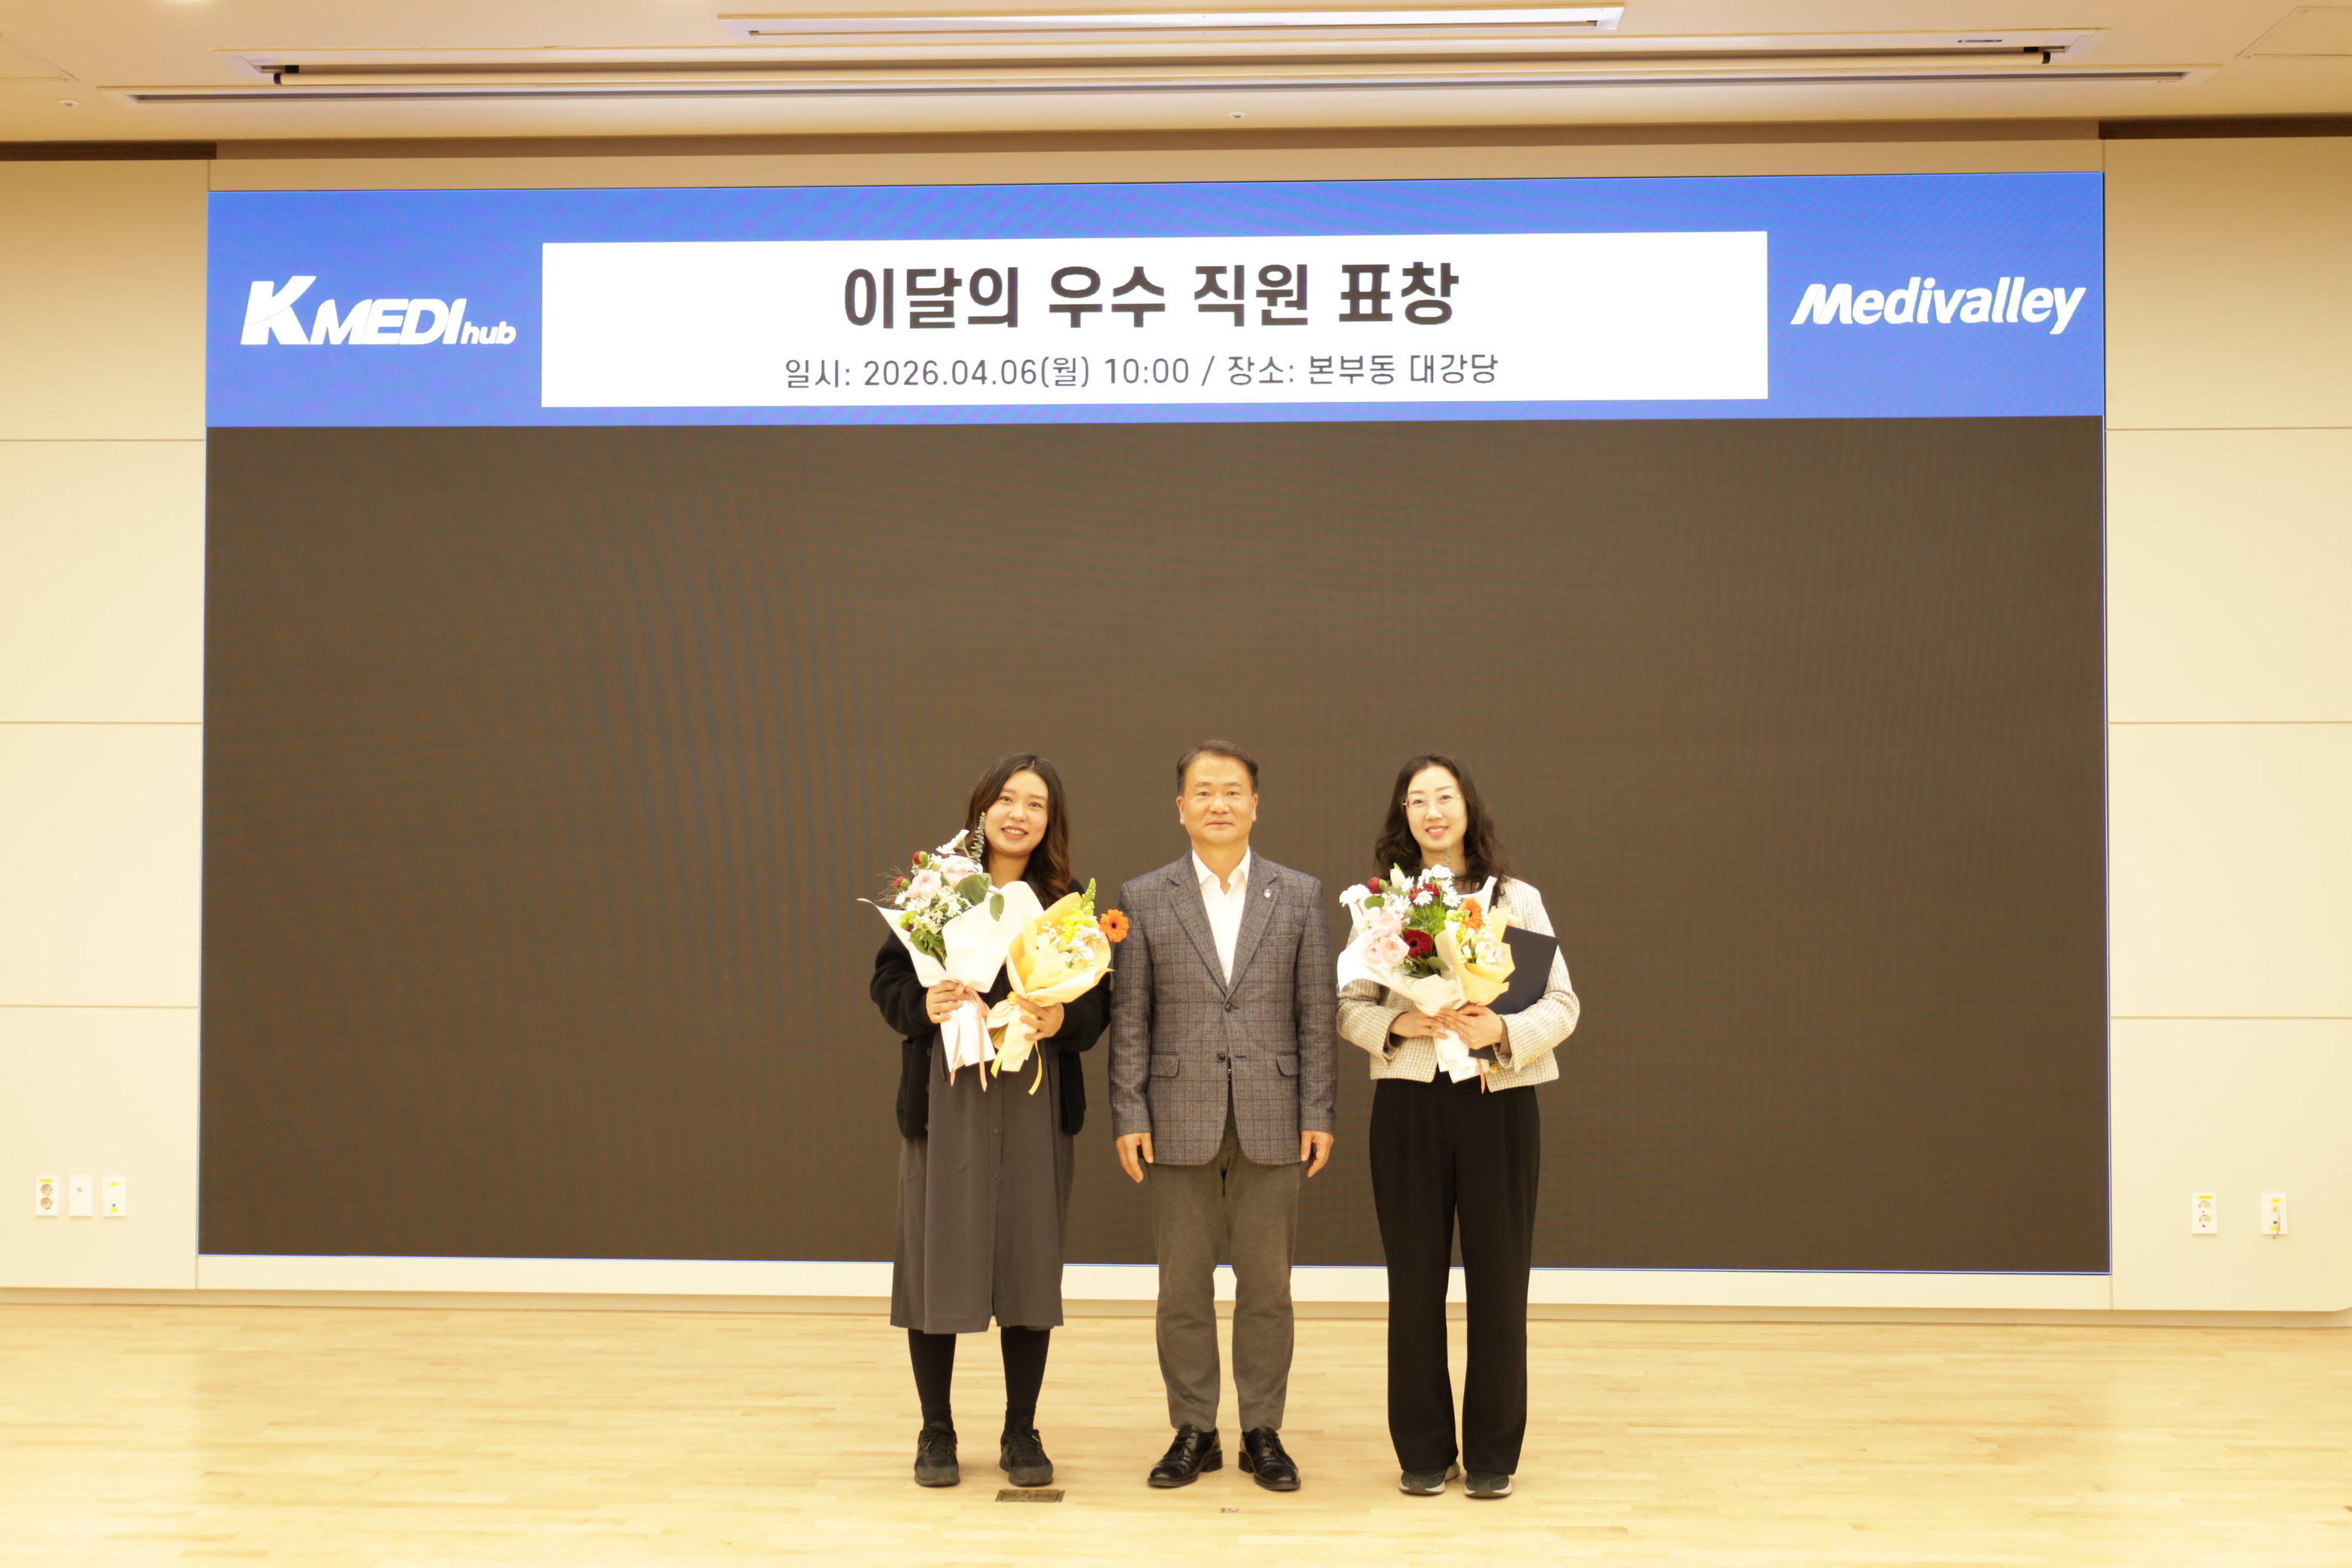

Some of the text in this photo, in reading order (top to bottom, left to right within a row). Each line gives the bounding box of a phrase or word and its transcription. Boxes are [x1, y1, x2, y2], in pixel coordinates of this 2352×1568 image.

[845, 262, 1459, 329] 이달의 우수 직원 표창
[1791, 277, 2086, 334] Medivalley
[786, 355, 1498, 387] 일시: 2026.04.06(월) 10:00 / 장소: 본부동 대강당
